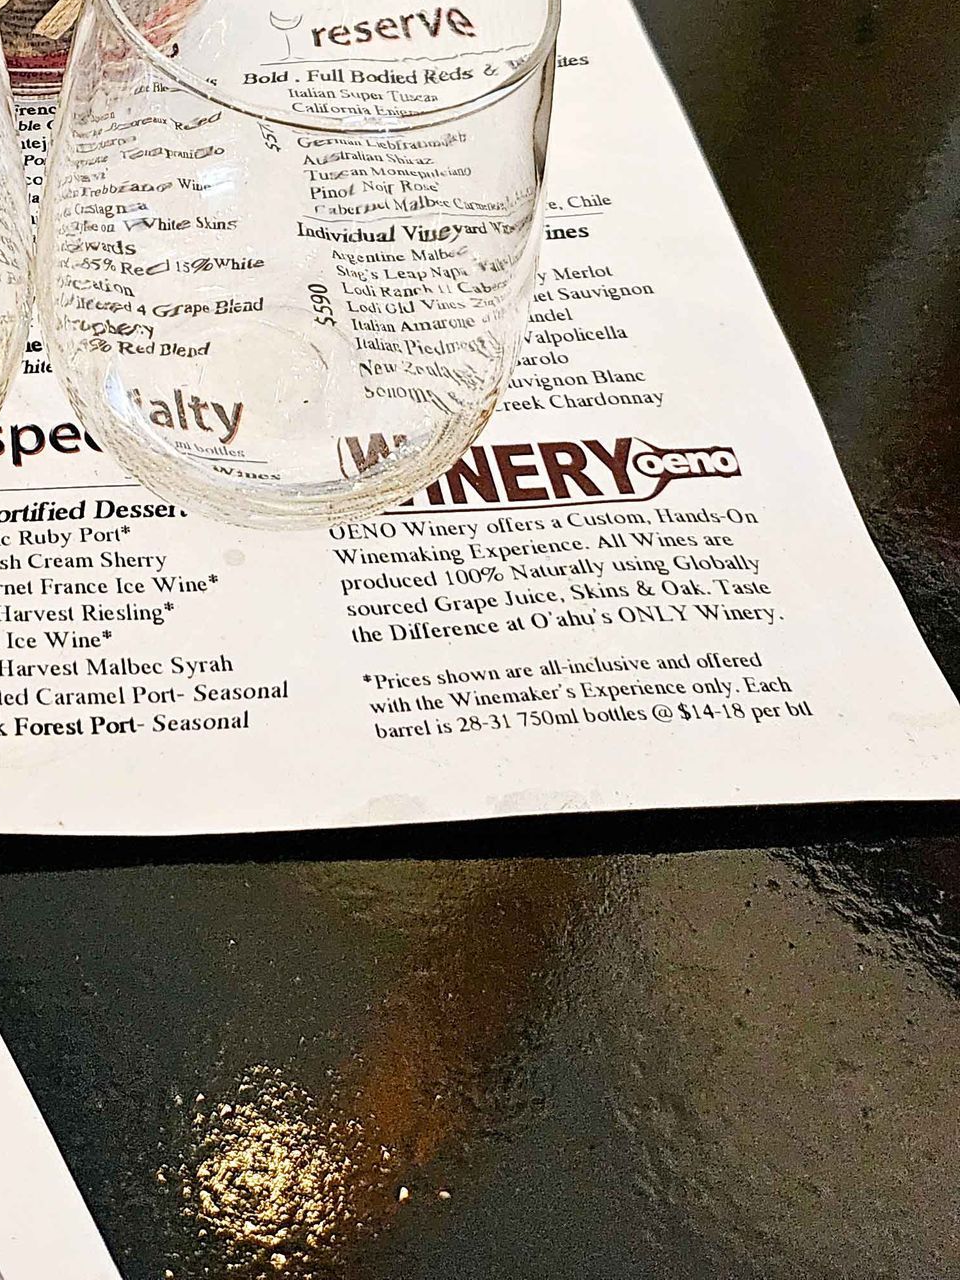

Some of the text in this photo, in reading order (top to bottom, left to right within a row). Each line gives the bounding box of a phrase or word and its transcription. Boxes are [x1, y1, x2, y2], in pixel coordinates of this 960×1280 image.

[311, 7, 477, 47] reserve
[307, 69, 345, 83] Full
[351, 69, 419, 85] Bodied
[568, 194, 611, 208] Chile
[297, 221, 395, 243] Individual
[553, 265, 614, 281] Merlot
[559, 283, 654, 301] Sauvignon
[308, 283, 337, 327] $590
[524, 326, 628, 347] Valpolicella
[591, 369, 646, 384] Blanc
[549, 391, 664, 409] Chardonnay
[399, 437, 739, 507] INERY oeno
[328, 507, 760, 541] OENO Winery offers a Custom, Hands-On
[18, 528, 73, 549] Ruby
[332, 531, 735, 566] Winemaking Experience. All Wines are
[27, 553, 95, 569] Cream
[100, 551, 167, 573] Sherry
[39, 578, 109, 595] France
[115, 577, 146, 594] Ice
[346, 578, 773, 617] sourced Grape Juice, Skins & Oak. Taste
[351, 603, 785, 644] the Difference at O'ahu's ONLY Winery.
[436, 668, 502, 685] shown
[505, 666, 534, 679] are
[539, 656, 652, 676] all-inclusive
[656, 653, 691, 670] and
[696, 651, 763, 669] offered
[35, 685, 126, 706] Caramel
[131, 686, 185, 705] Port-
[193, 679, 289, 702] Seasonal
[13, 716, 85, 737] Forest
[89, 715, 145, 736] Port-
[152, 709, 249, 733] Seasonal
[374, 700, 814, 739] barrel is 28-31 750ml bottles @ $14-18 per btl
